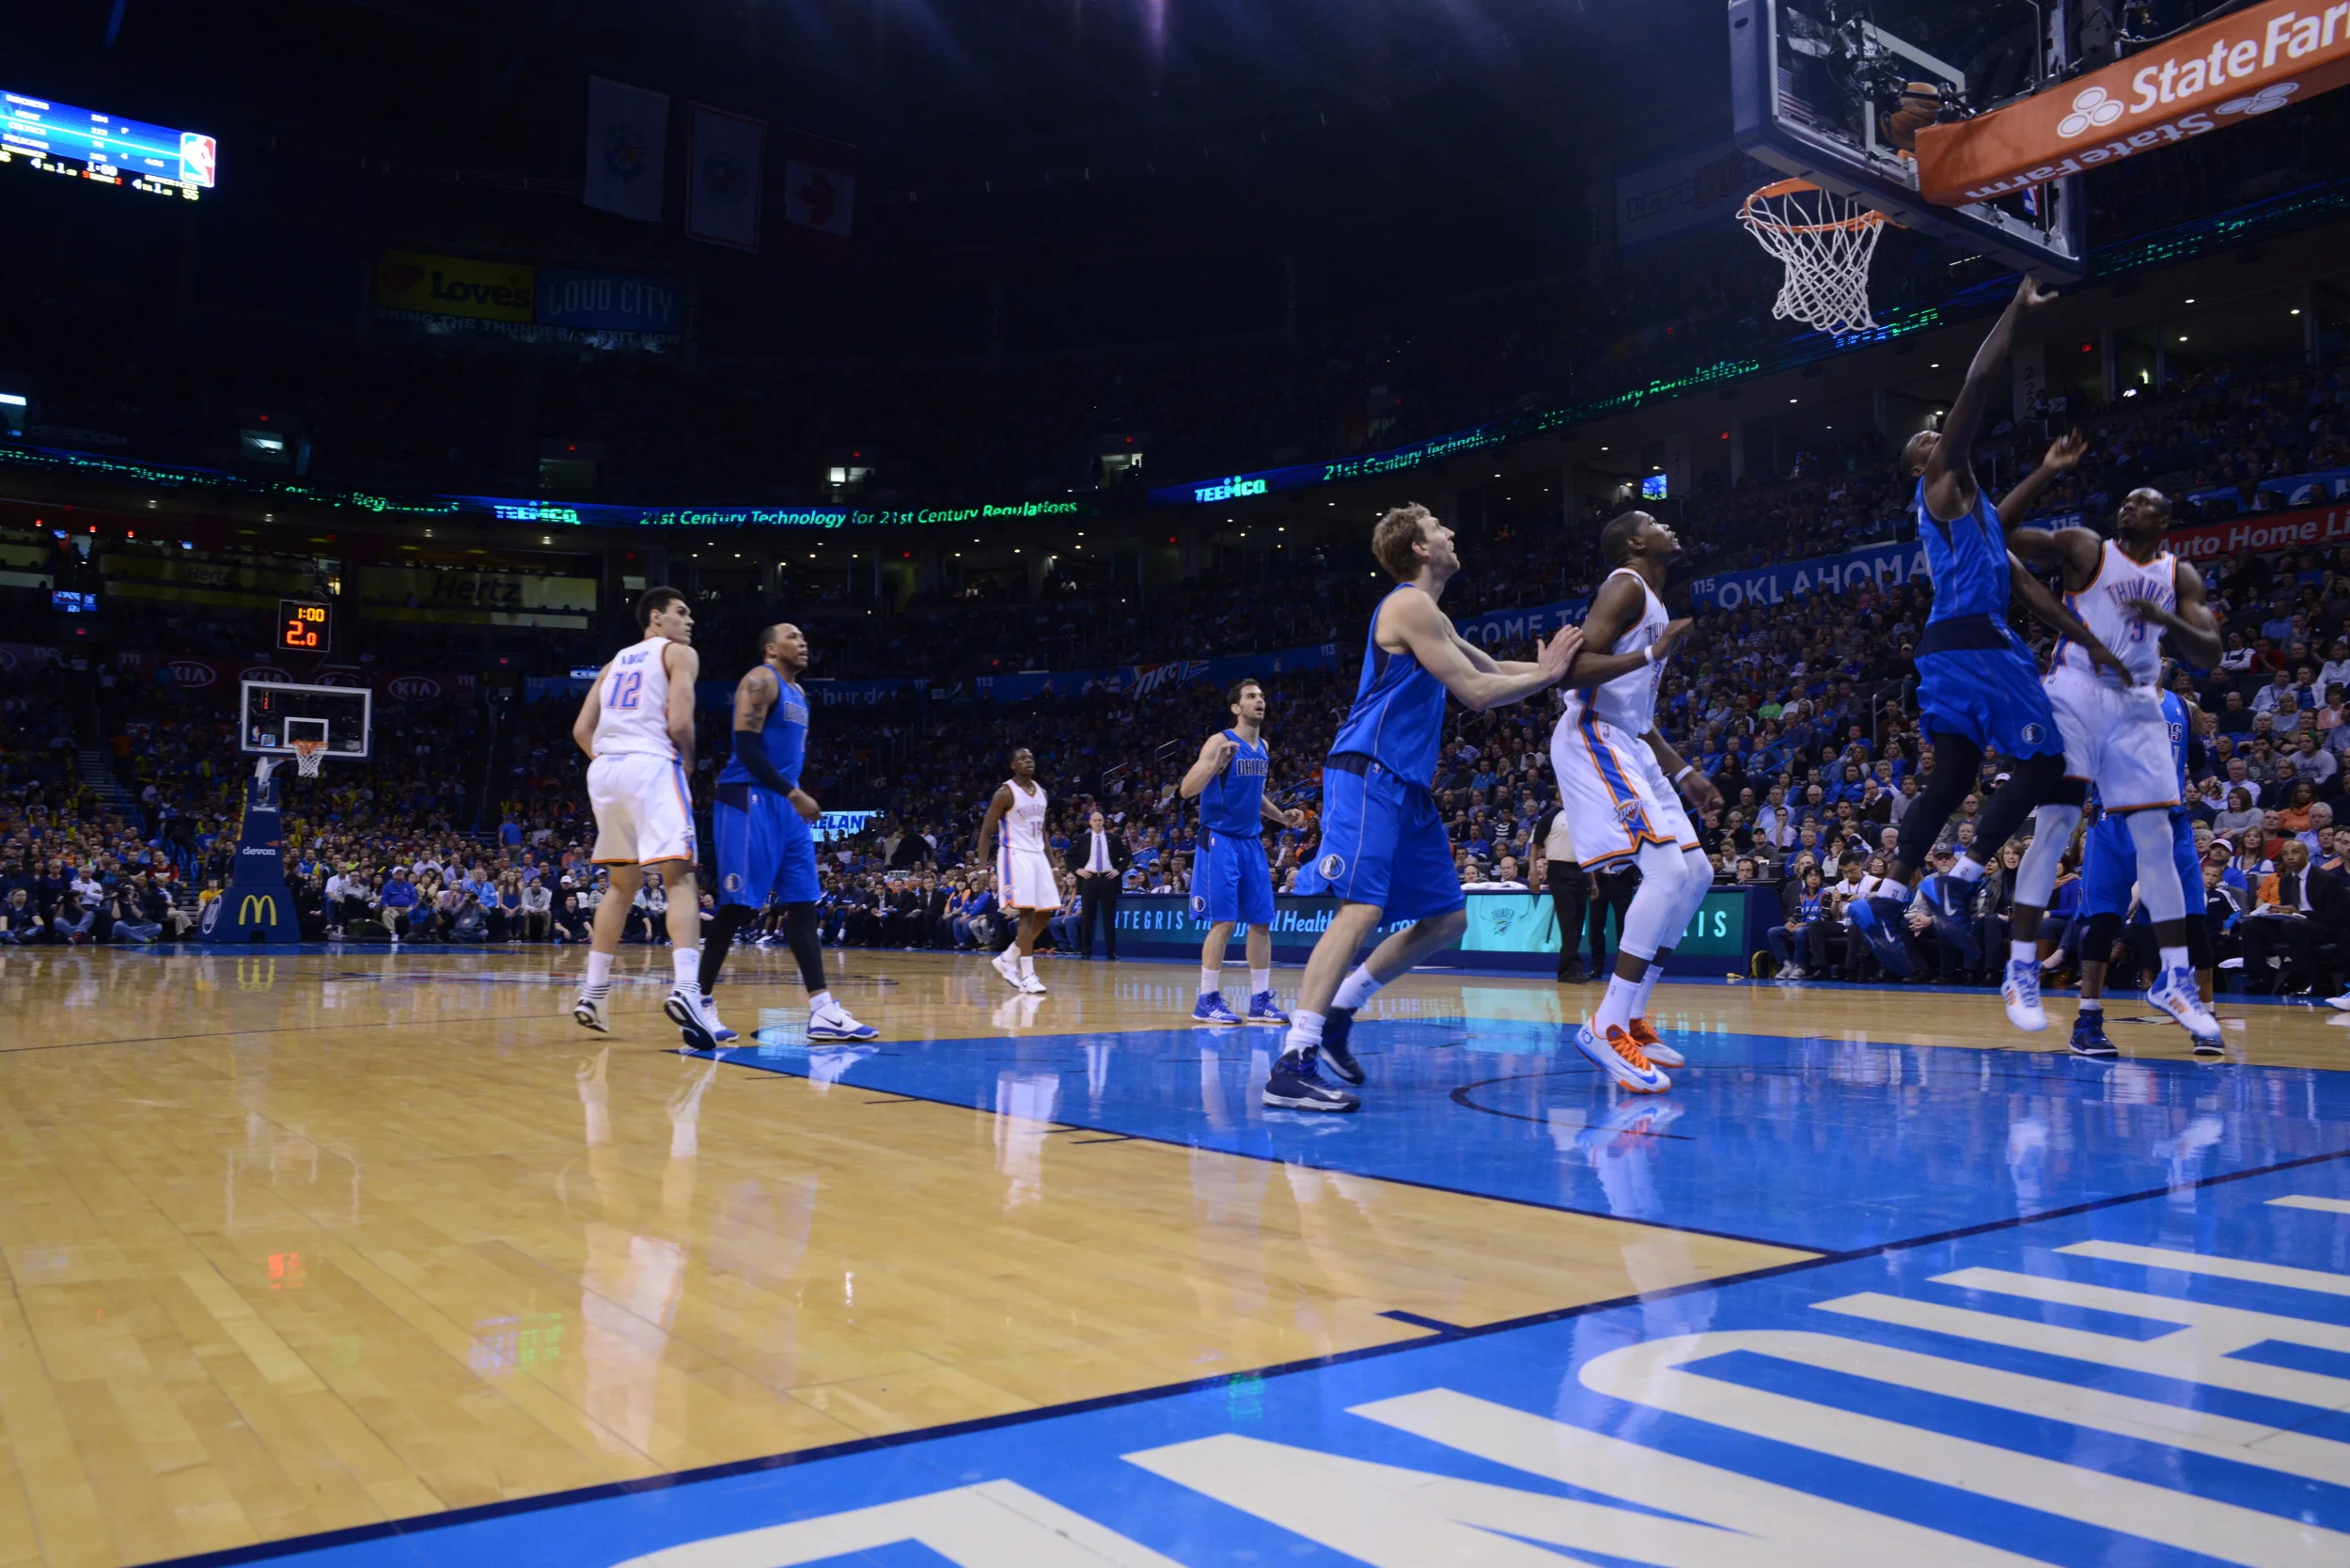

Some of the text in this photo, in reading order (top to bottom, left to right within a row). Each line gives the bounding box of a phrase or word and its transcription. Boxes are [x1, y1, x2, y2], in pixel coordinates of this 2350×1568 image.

[548, 279, 674, 323] LOUD CITY
[751, 510, 846, 529] Technology
[879, 511, 915, 525] 21st
[917, 509, 979, 525] Century
[2156, 534, 2221, 557] Auto
[2229, 520, 2318, 552] Home
[433, 574, 521, 603] Hertz
[1693, 549, 1933, 613] 115 OKLAHOMA
[298, 607, 325, 622] 1:00
[286, 620, 317, 647] 2.0
[1463, 614, 1547, 649] COME
[1319, 643, 1336, 657] 113
[397, 682, 431, 697] KIA
[604, 669, 644, 711] 12
[976, 677, 995, 687] 113
[242, 846, 276, 856] devon
[1115, 910, 1184, 930] TEGRIS
